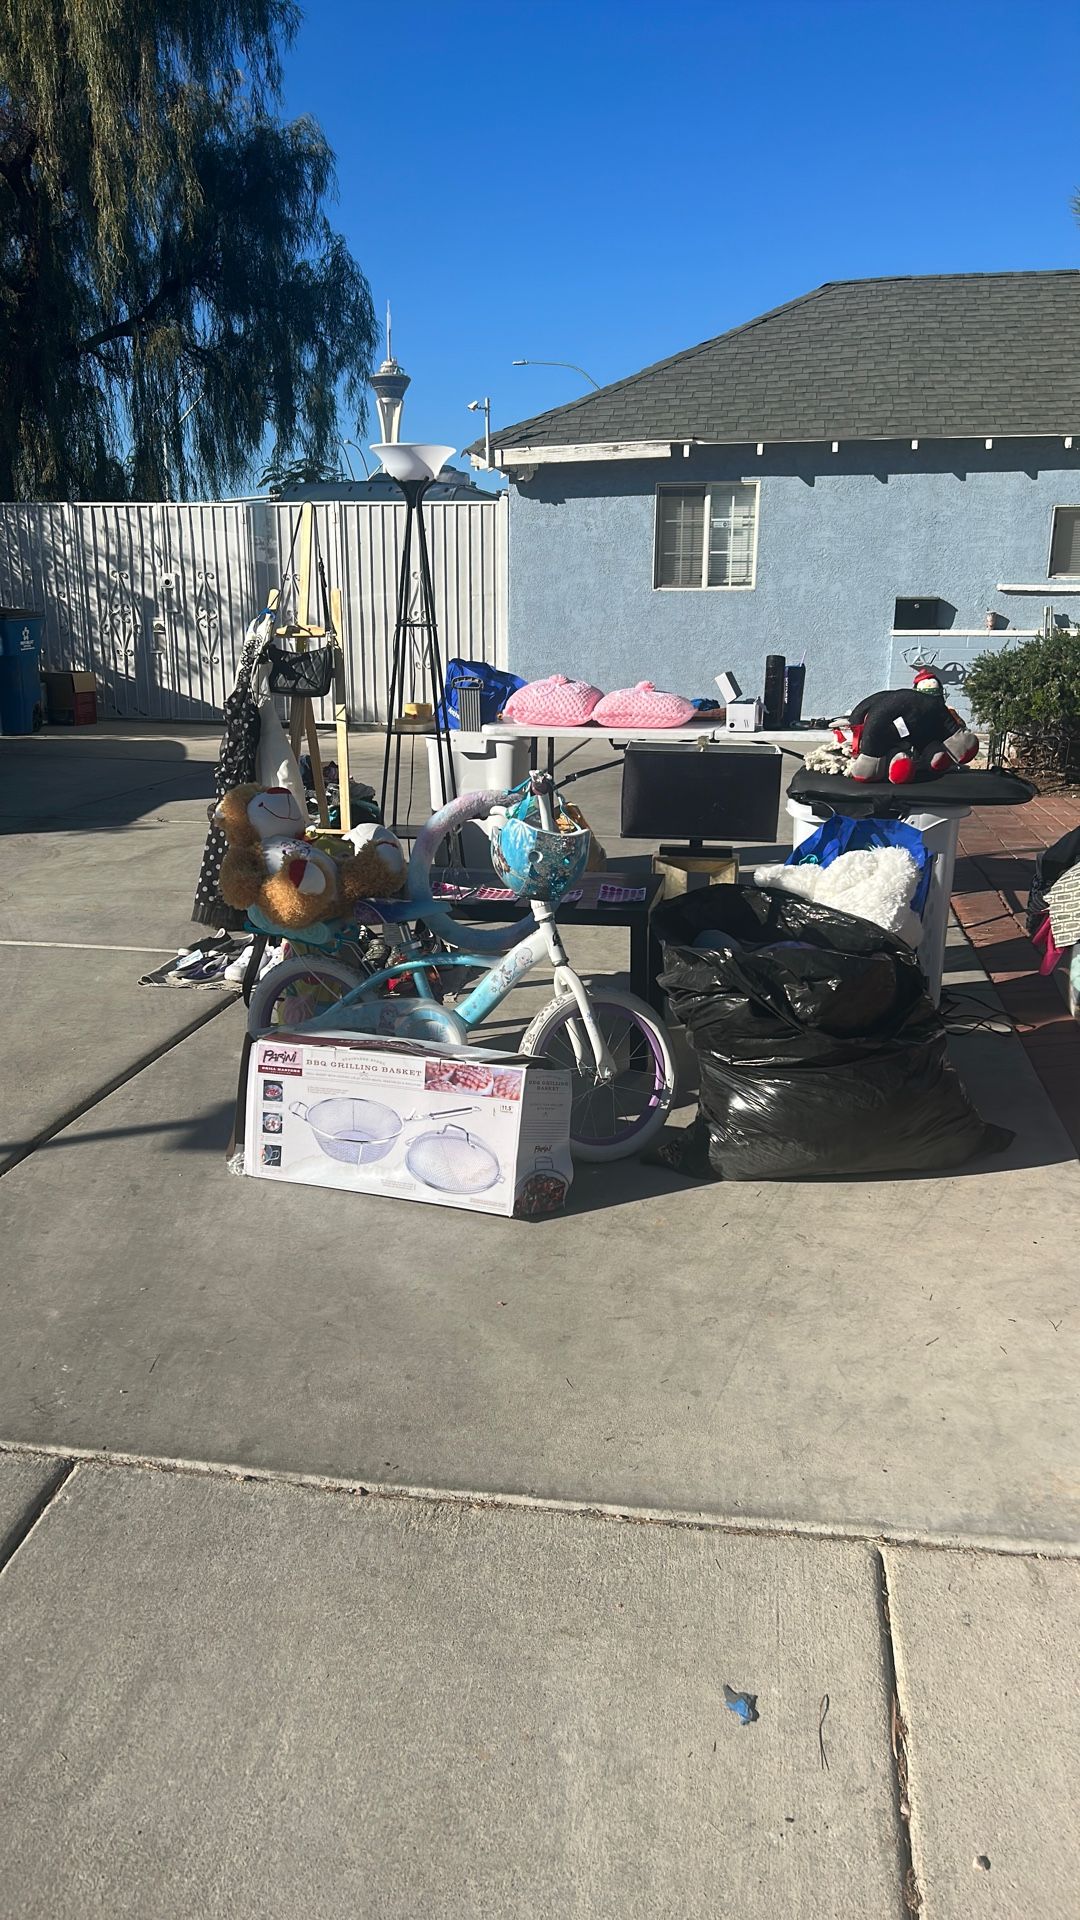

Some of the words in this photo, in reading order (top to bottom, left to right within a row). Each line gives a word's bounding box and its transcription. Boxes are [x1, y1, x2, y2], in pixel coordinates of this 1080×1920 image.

[306, 1059, 327, 1067] BBQ
[330, 1061, 379, 1072] GRILLING
[381, 1066, 422, 1077] BASKET
